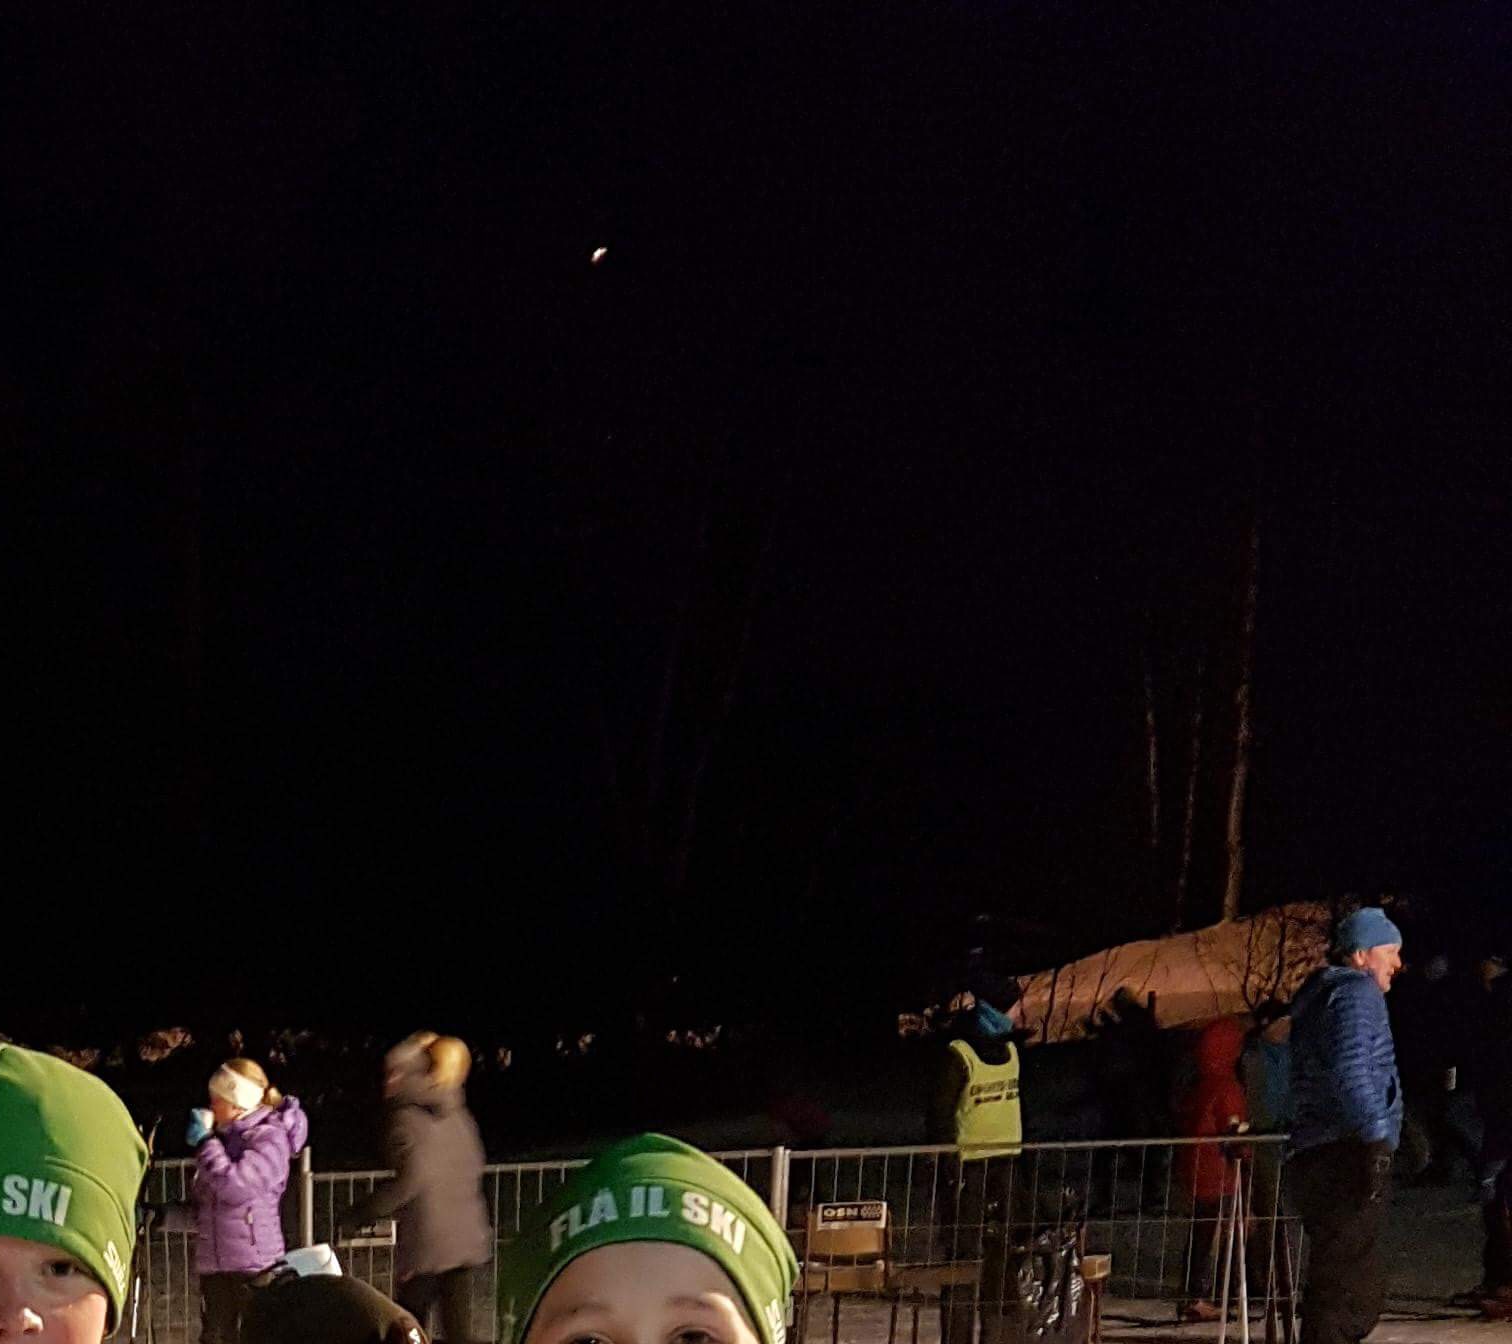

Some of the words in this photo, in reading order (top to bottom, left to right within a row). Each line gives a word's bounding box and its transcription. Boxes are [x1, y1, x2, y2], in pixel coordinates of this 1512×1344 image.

[2, 1174, 72, 1227] SKI
[549, 1187, 619, 1250] FLÅ
[629, 1185, 671, 1218] IL
[681, 1190, 747, 1255] SKI
